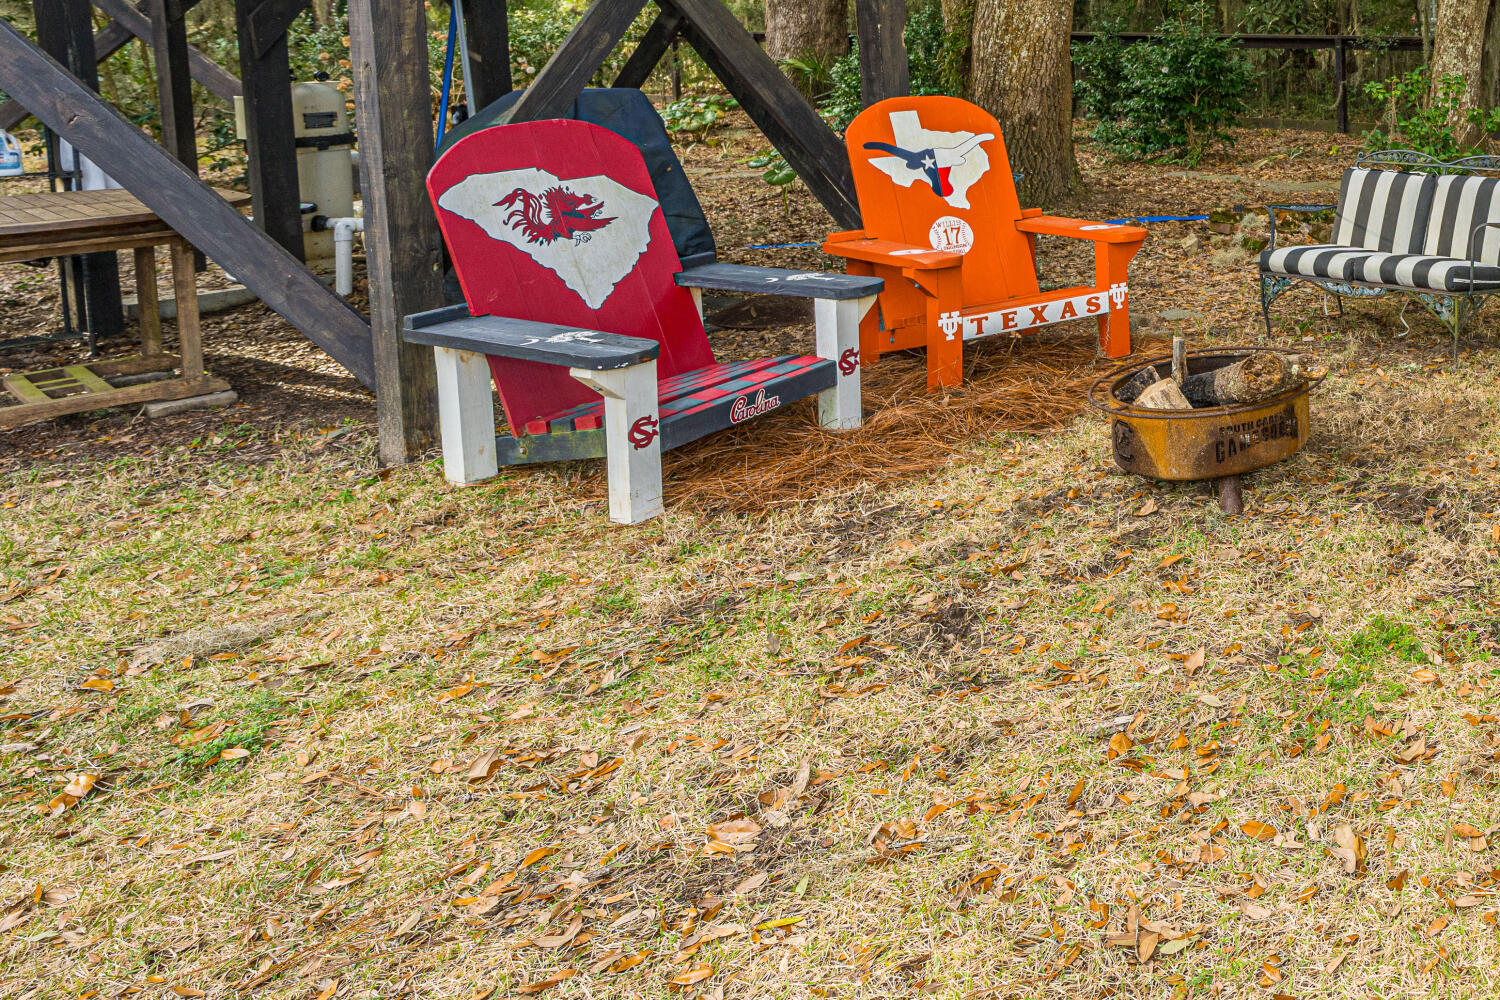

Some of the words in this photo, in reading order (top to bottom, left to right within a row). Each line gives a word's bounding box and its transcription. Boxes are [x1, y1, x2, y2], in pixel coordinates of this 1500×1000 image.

[943, 226, 961, 245] 17
[969, 296, 1102, 336] TEXAS
[730, 388, 781, 424] Carolina
[1219, 420, 1254, 435] SOUTH
[1255, 404, 1295, 428] CARO
[1215, 414, 1299, 464] GAMECO
